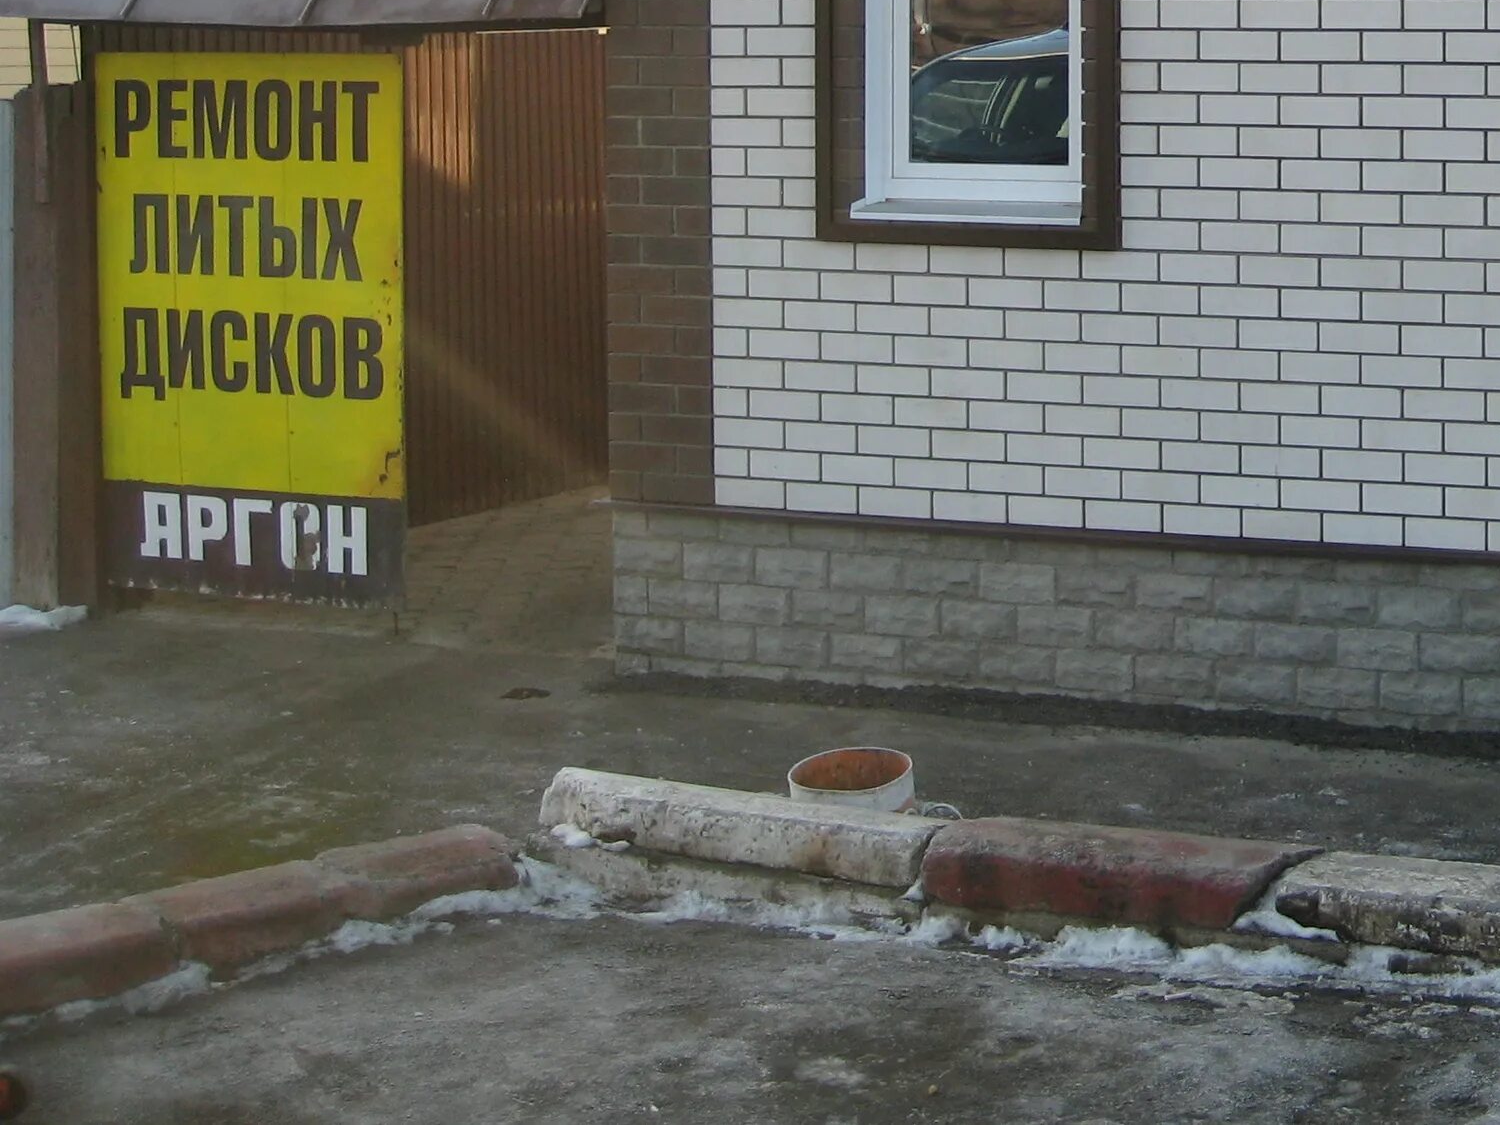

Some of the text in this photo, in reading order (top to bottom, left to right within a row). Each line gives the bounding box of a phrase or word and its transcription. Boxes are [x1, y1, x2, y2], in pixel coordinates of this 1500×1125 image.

[113, 78, 380, 163] РЕМОНТ
[129, 193, 364, 282] ЛИТЫХ
[120, 306, 385, 401] ДИСКОВ
[140, 490, 368, 576] АРГОН
